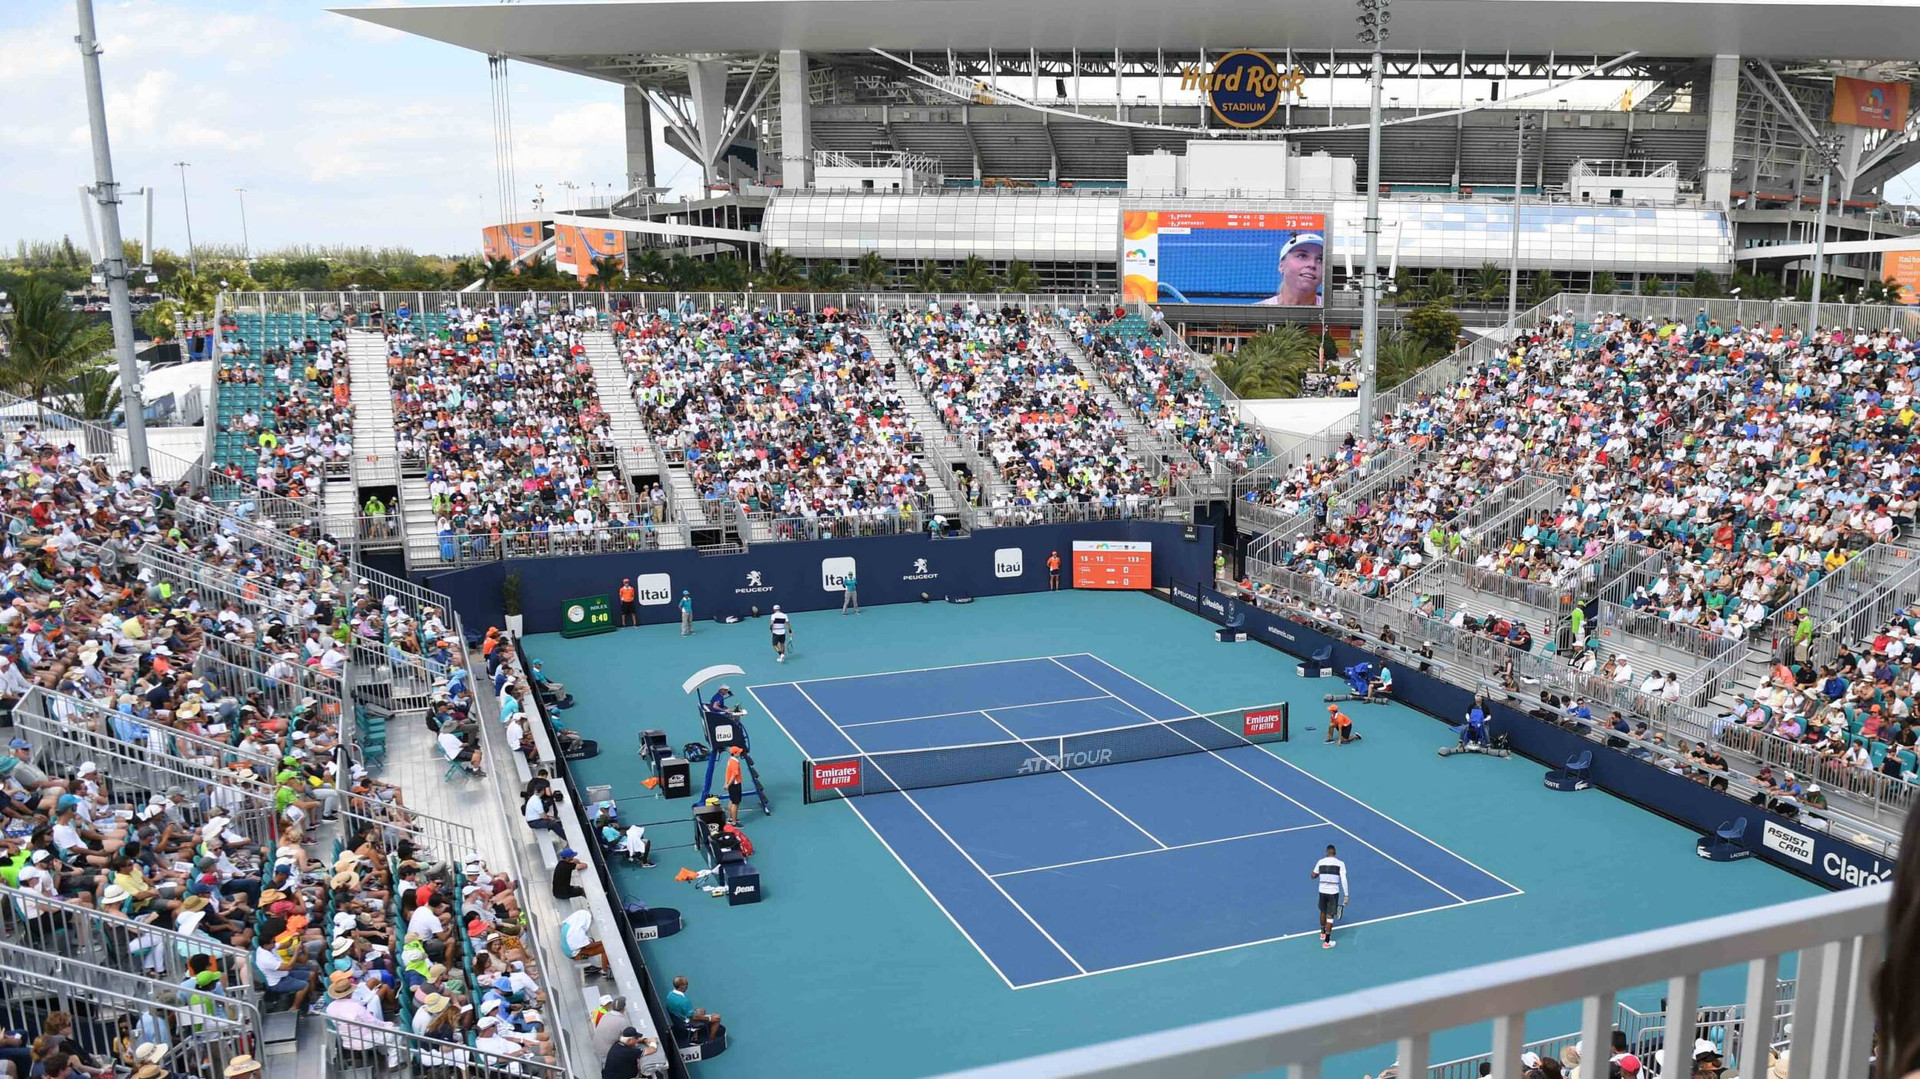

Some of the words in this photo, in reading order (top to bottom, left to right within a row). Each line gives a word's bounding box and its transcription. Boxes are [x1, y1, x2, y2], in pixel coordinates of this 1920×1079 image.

[1180, 65, 1243, 92] Hard
[1245, 65, 1306, 98] Rock
[1222, 103, 1266, 112] STADIUM
[996, 562, 1021, 574] Itaú
[825, 574, 847, 586] Ita
[903, 573, 938, 581] PEUGEOT
[641, 588, 669, 601] Itaú
[735, 586, 774, 594] PEUGEOT
[1177, 589, 1197, 603] PEUGEOT
[591, 612, 609, 623] 0:40
[1246, 713, 1279, 725] Emirates
[717, 731, 732, 739] Itaú
[1063, 748, 1112, 768] TOUR
[815, 767, 857, 778] Emirates
[822, 778, 831, 786] FLY
[1545, 779, 1560, 789] COSTE
[1767, 826, 1808, 848] ASSIST
[1730, 850, 1750, 859] LACOSTE
[1778, 841, 1809, 859] CARD
[636, 929, 657, 940] Itaú
[681, 1050, 700, 1062] taú
